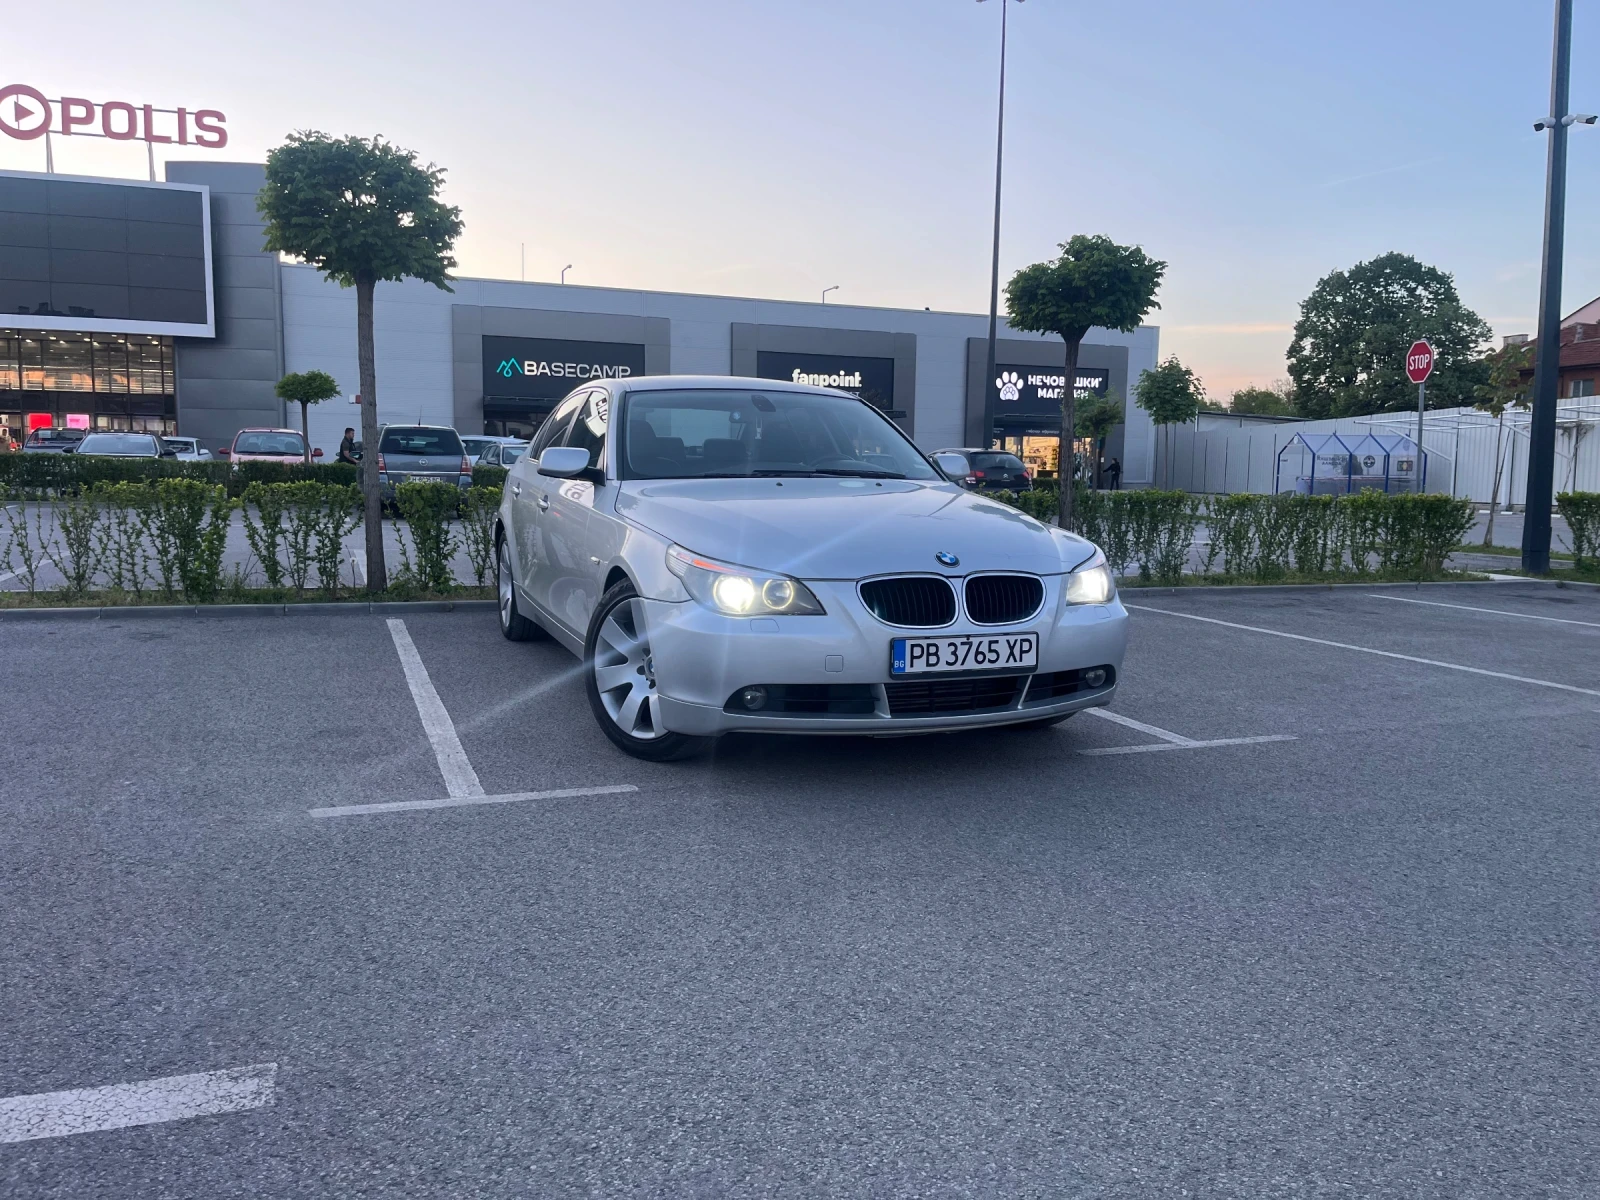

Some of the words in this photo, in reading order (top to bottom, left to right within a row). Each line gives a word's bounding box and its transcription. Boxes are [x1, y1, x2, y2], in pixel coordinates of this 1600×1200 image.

[524, 361, 631, 379] BASECAMP
[1409, 354, 1430, 370] STOP
[792, 368, 862, 387] fanpoint
[1027, 375, 1101, 388] НЕЧОВШКИ
[910, 643, 940, 668] PB
[945, 640, 1000, 666] 3765
[1005, 638, 1033, 663] XP
